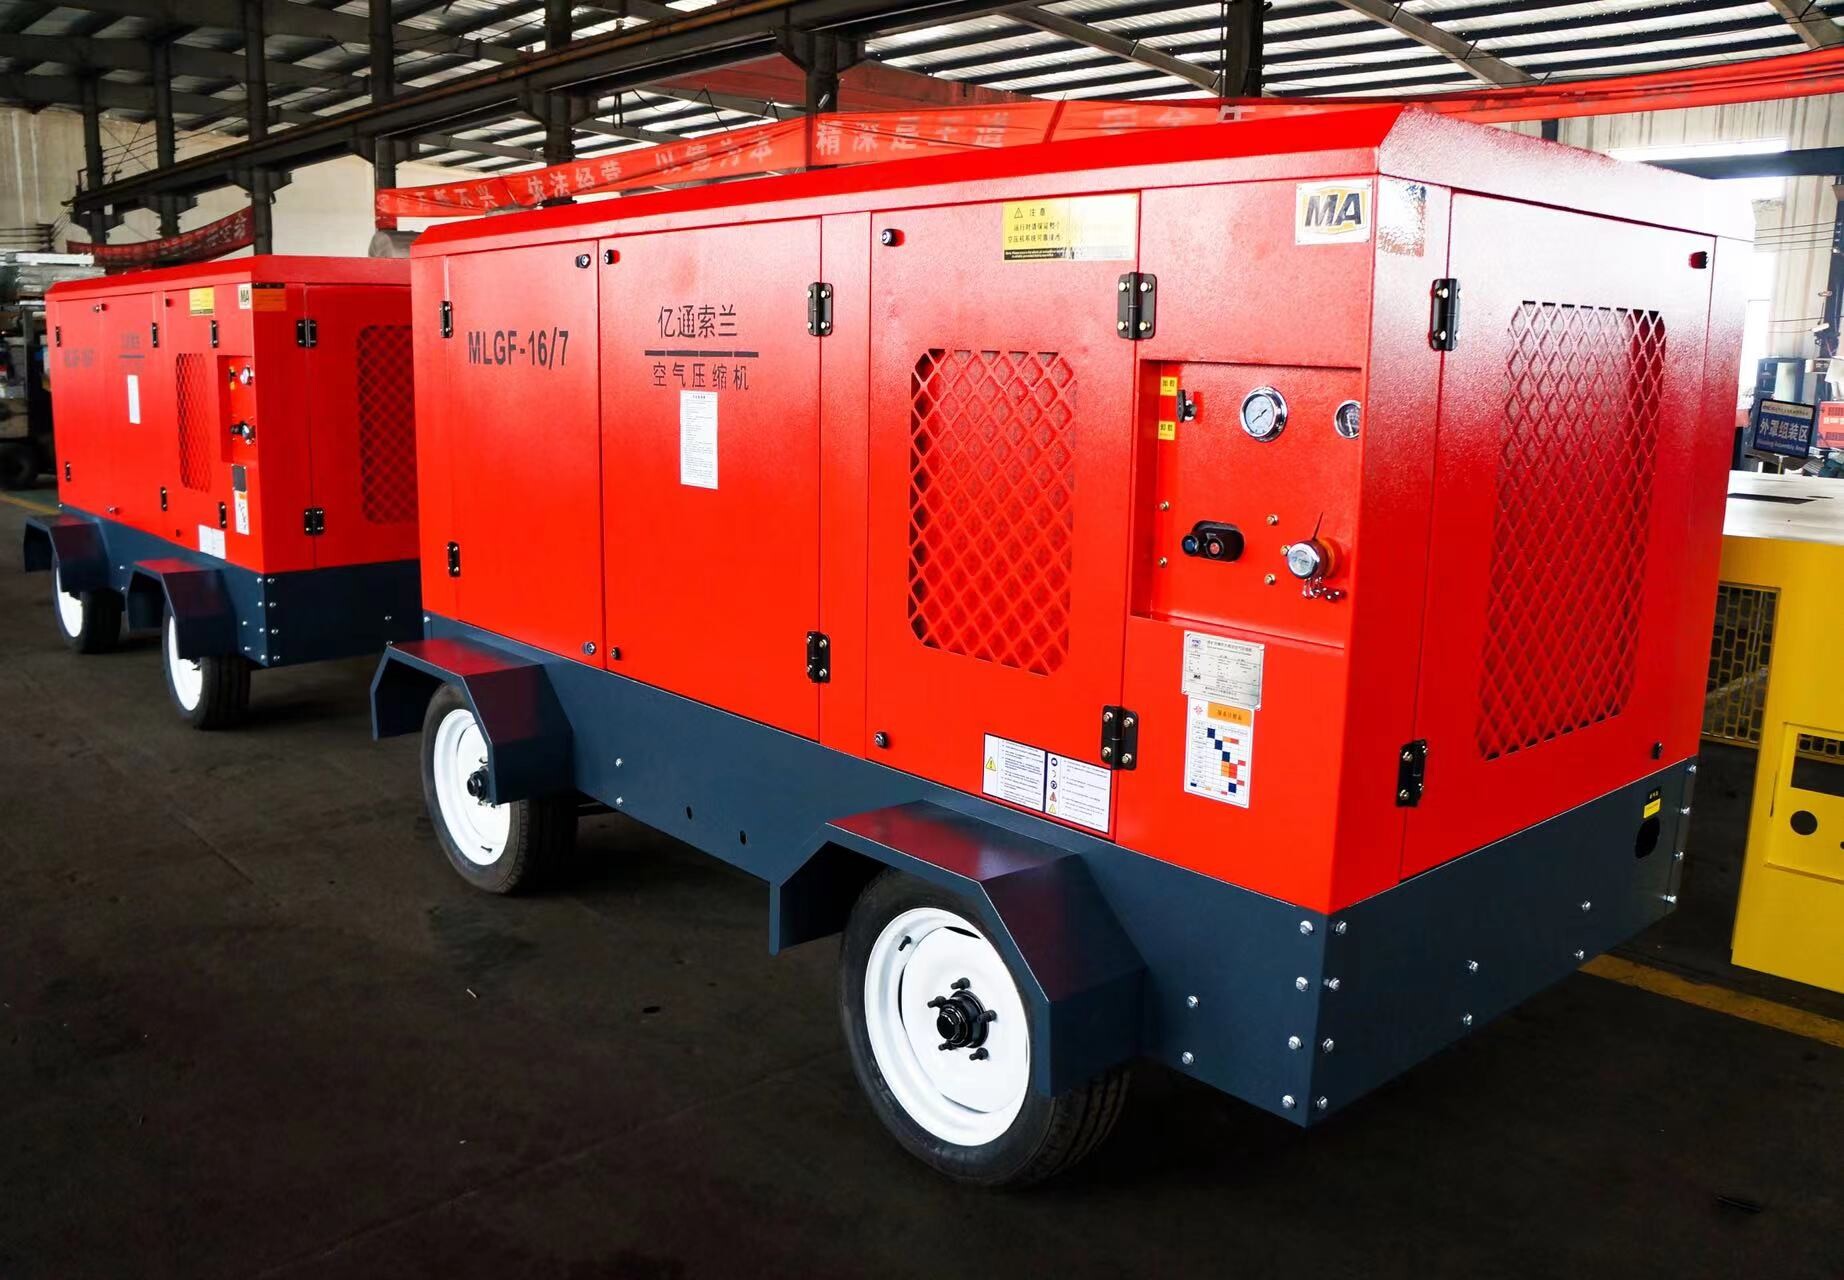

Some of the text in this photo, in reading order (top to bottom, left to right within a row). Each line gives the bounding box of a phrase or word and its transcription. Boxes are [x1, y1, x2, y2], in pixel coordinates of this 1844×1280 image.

[1304, 192, 1363, 228] MA
[657, 304, 738, 340] 亿通索兰
[467, 326, 570, 370] MLGF-16/7
[652, 361, 750, 391] 空气压缩机
[1760, 418, 1809, 442] 外罩组装区
